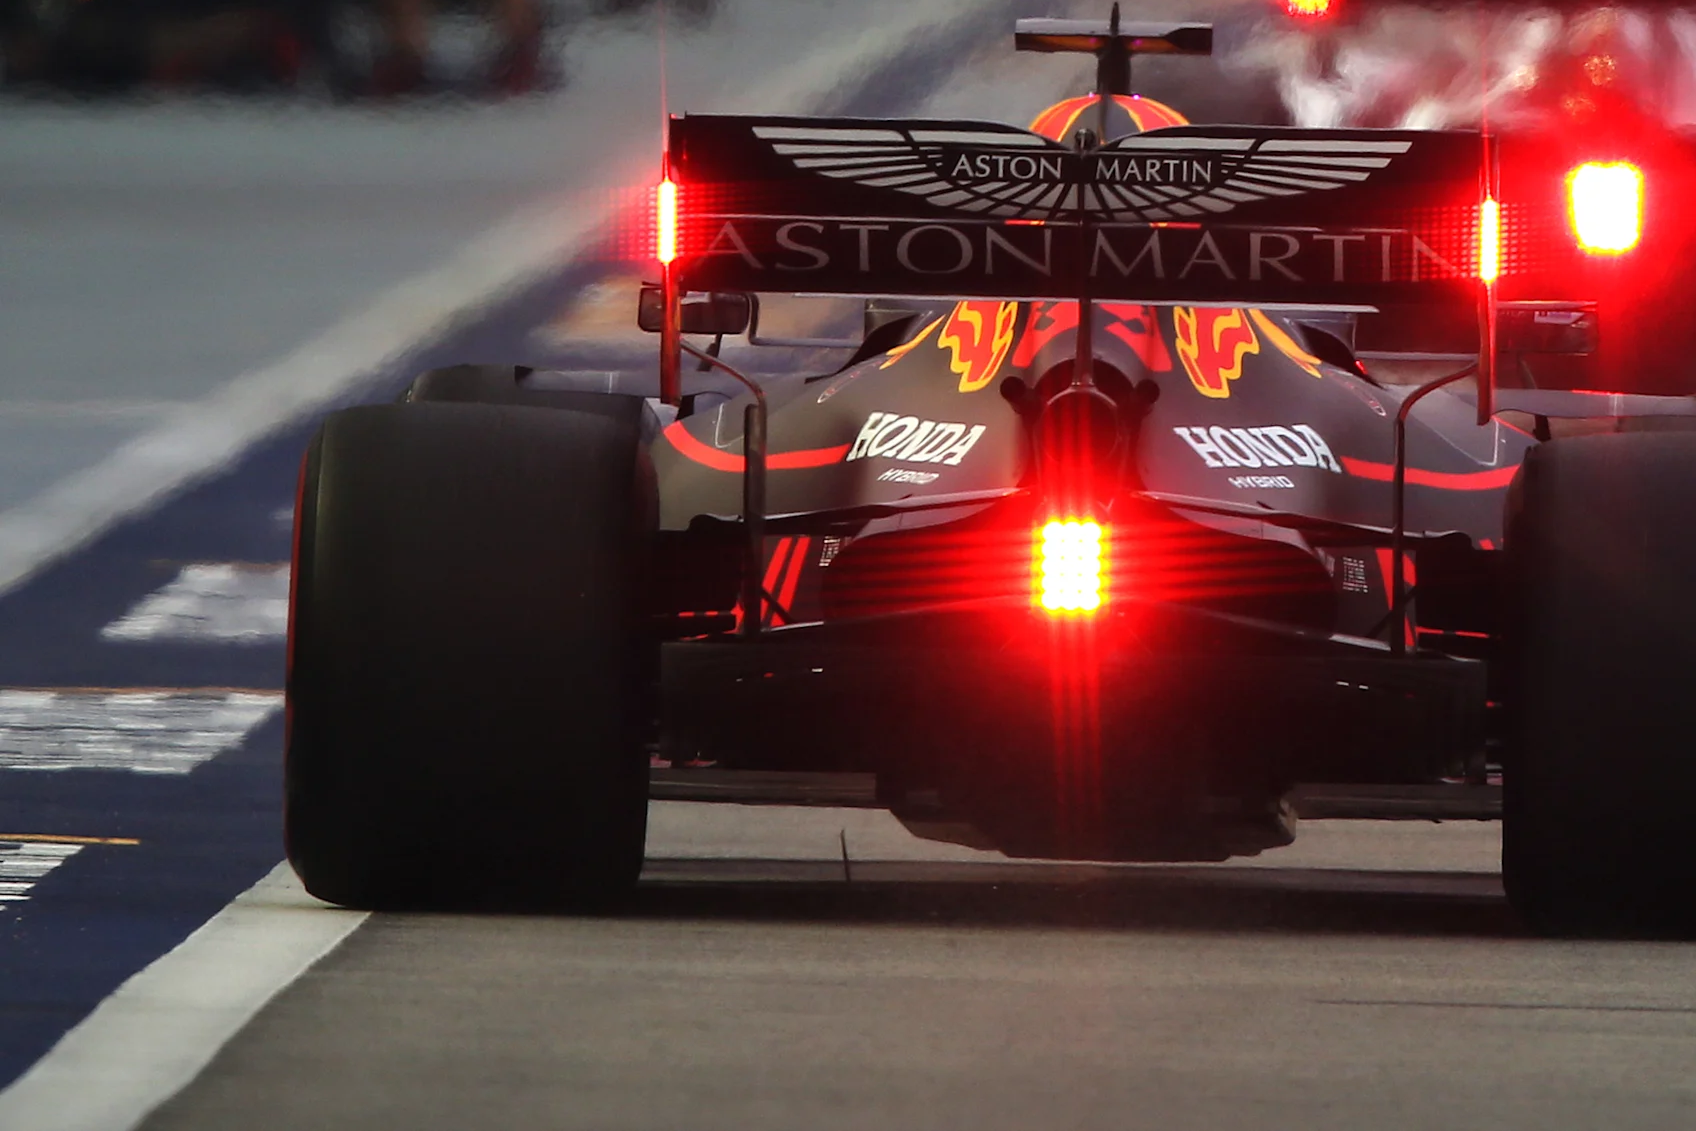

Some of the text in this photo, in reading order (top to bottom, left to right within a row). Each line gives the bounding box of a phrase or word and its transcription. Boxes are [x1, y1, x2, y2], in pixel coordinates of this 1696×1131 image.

[951, 154, 1212, 183] ASTON MARTIN
[695, 220, 1053, 278] ASTON
[846, 411, 987, 466] HONDA
[1172, 424, 1342, 474] HONDA
[1227, 474, 1295, 489] HYBRID
